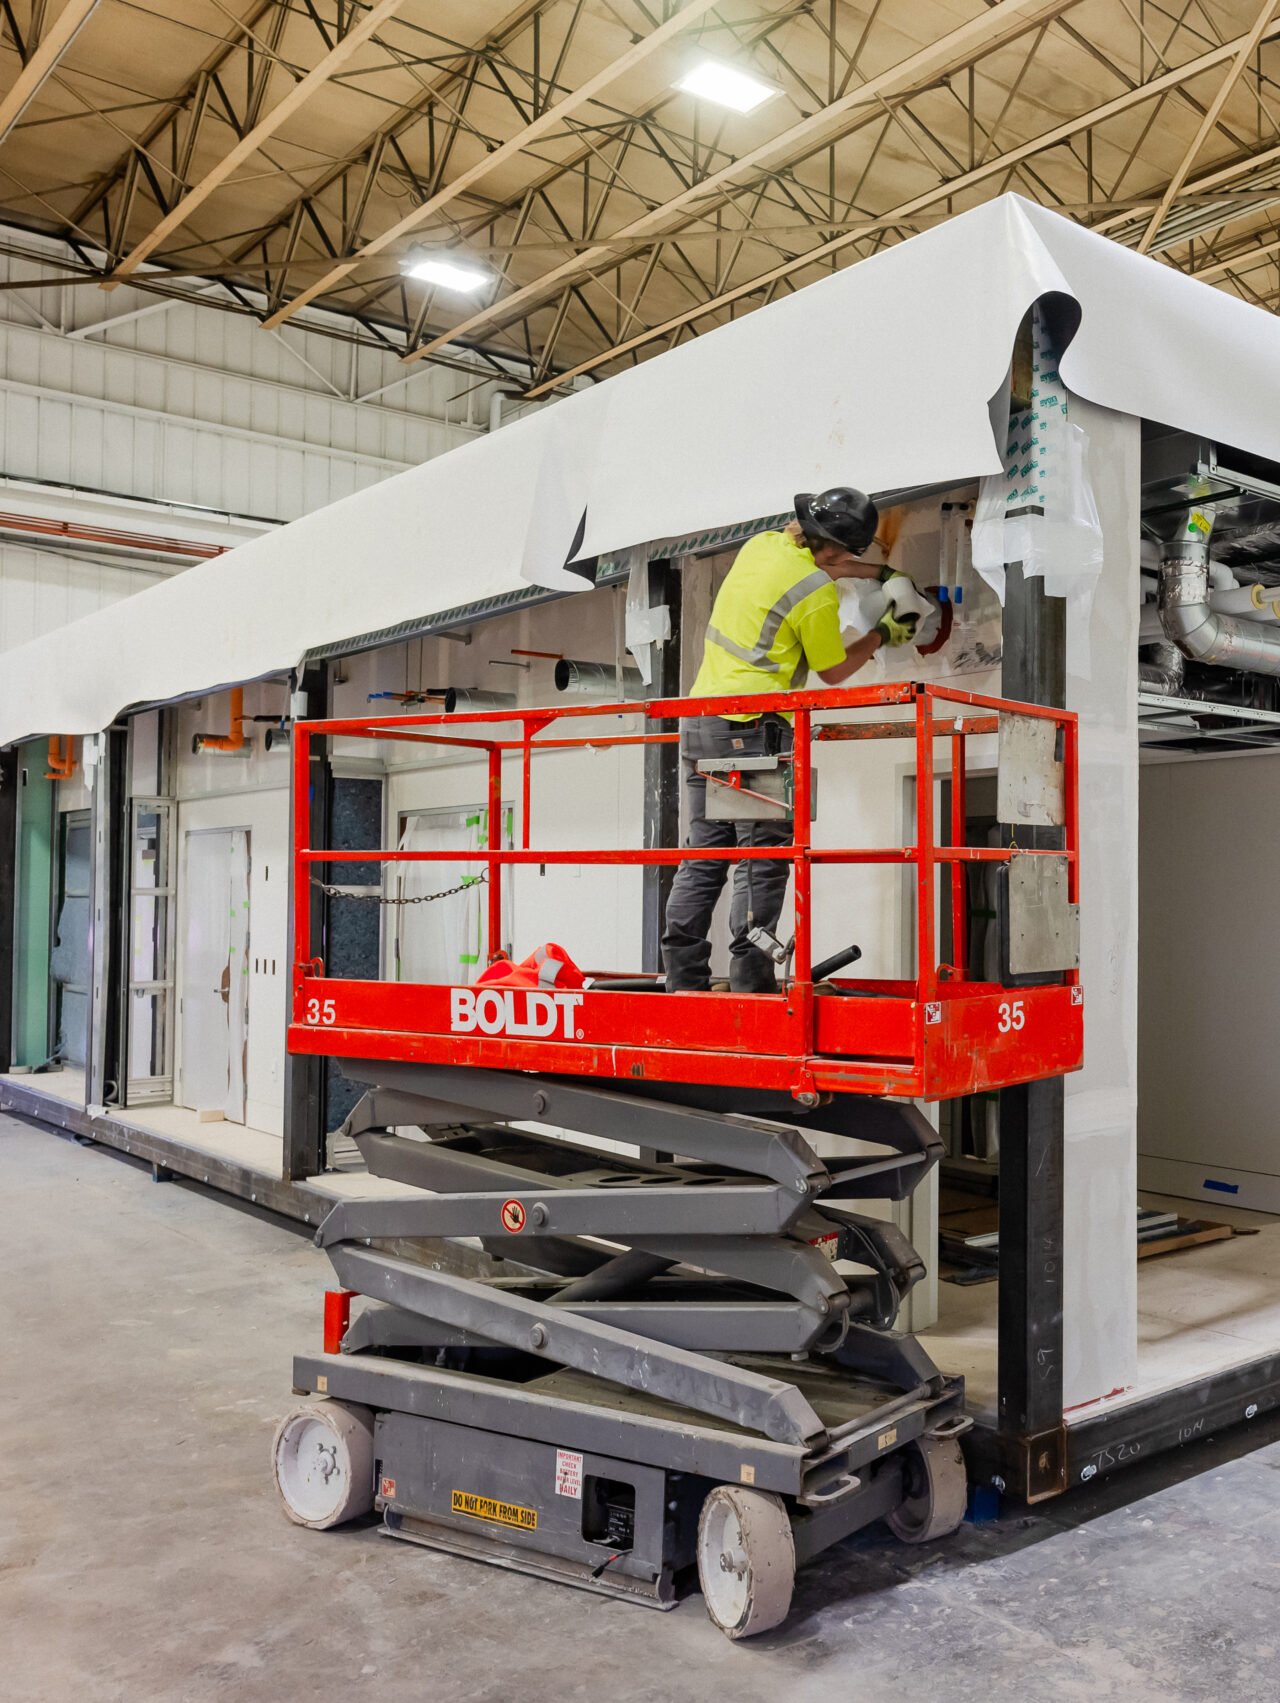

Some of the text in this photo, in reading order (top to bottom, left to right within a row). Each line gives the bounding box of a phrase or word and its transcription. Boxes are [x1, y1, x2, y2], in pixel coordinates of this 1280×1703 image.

[307, 998, 336, 1025] 35
[998, 1001, 1026, 1033] 35
[557, 1451, 582, 1463] IMPORTANT
[562, 1461, 577, 1469] CHECK
[559, 1483, 577, 1496] DAILY
[453, 1492, 536, 1527] DO NOT FORK FROM SIDE
